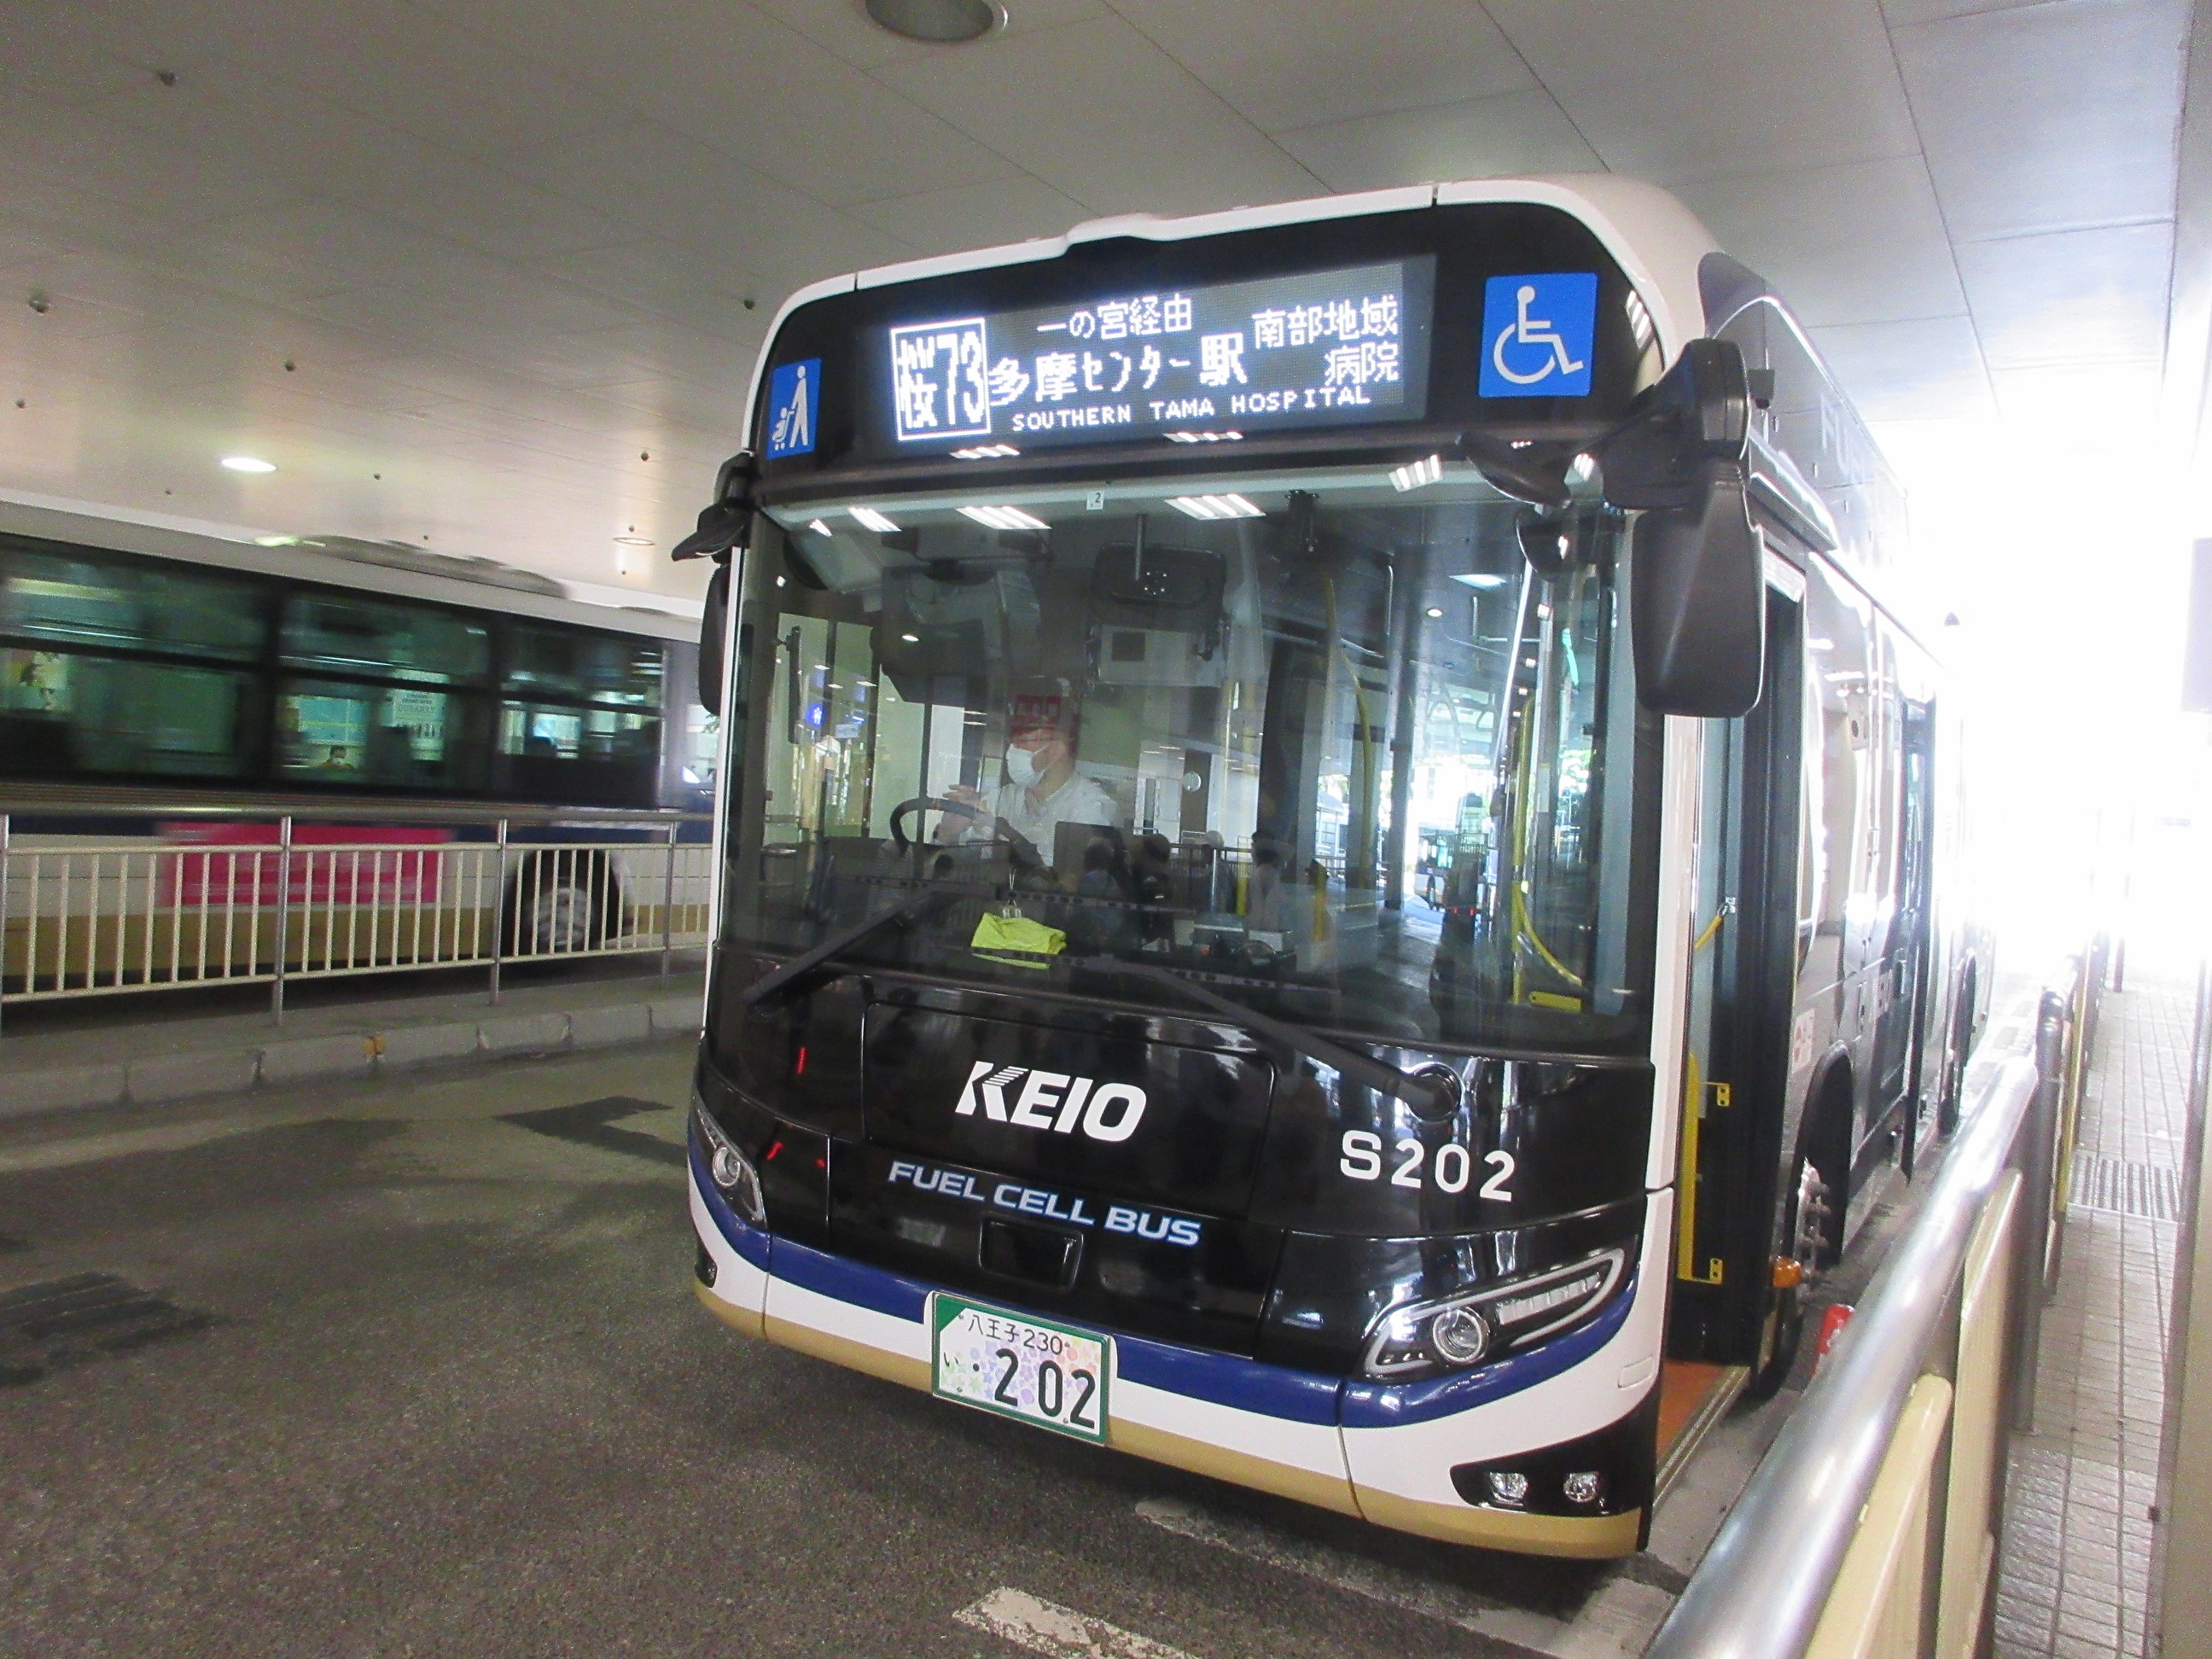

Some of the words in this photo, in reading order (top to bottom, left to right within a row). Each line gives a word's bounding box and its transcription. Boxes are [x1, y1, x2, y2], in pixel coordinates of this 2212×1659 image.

[1037, 293, 1192, 340] 一の宮経由
[1251, 294, 1398, 350] 南部地域
[987, 332, 1248, 407] 多摩センター駅
[1324, 341, 1399, 387] 病院
[1012, 404, 1132, 432] SOUTHERN
[1149, 398, 1214, 421] TAMA
[1231, 386, 1371, 414] HOSPITAL
[954, 1060, 1147, 1143] KEIO
[1340, 1129, 1516, 1202] S202
[888, 1160, 986, 1202] FUEL
[992, 1183, 1095, 1225] CELL
[1103, 1205, 1202, 1248] BUS
